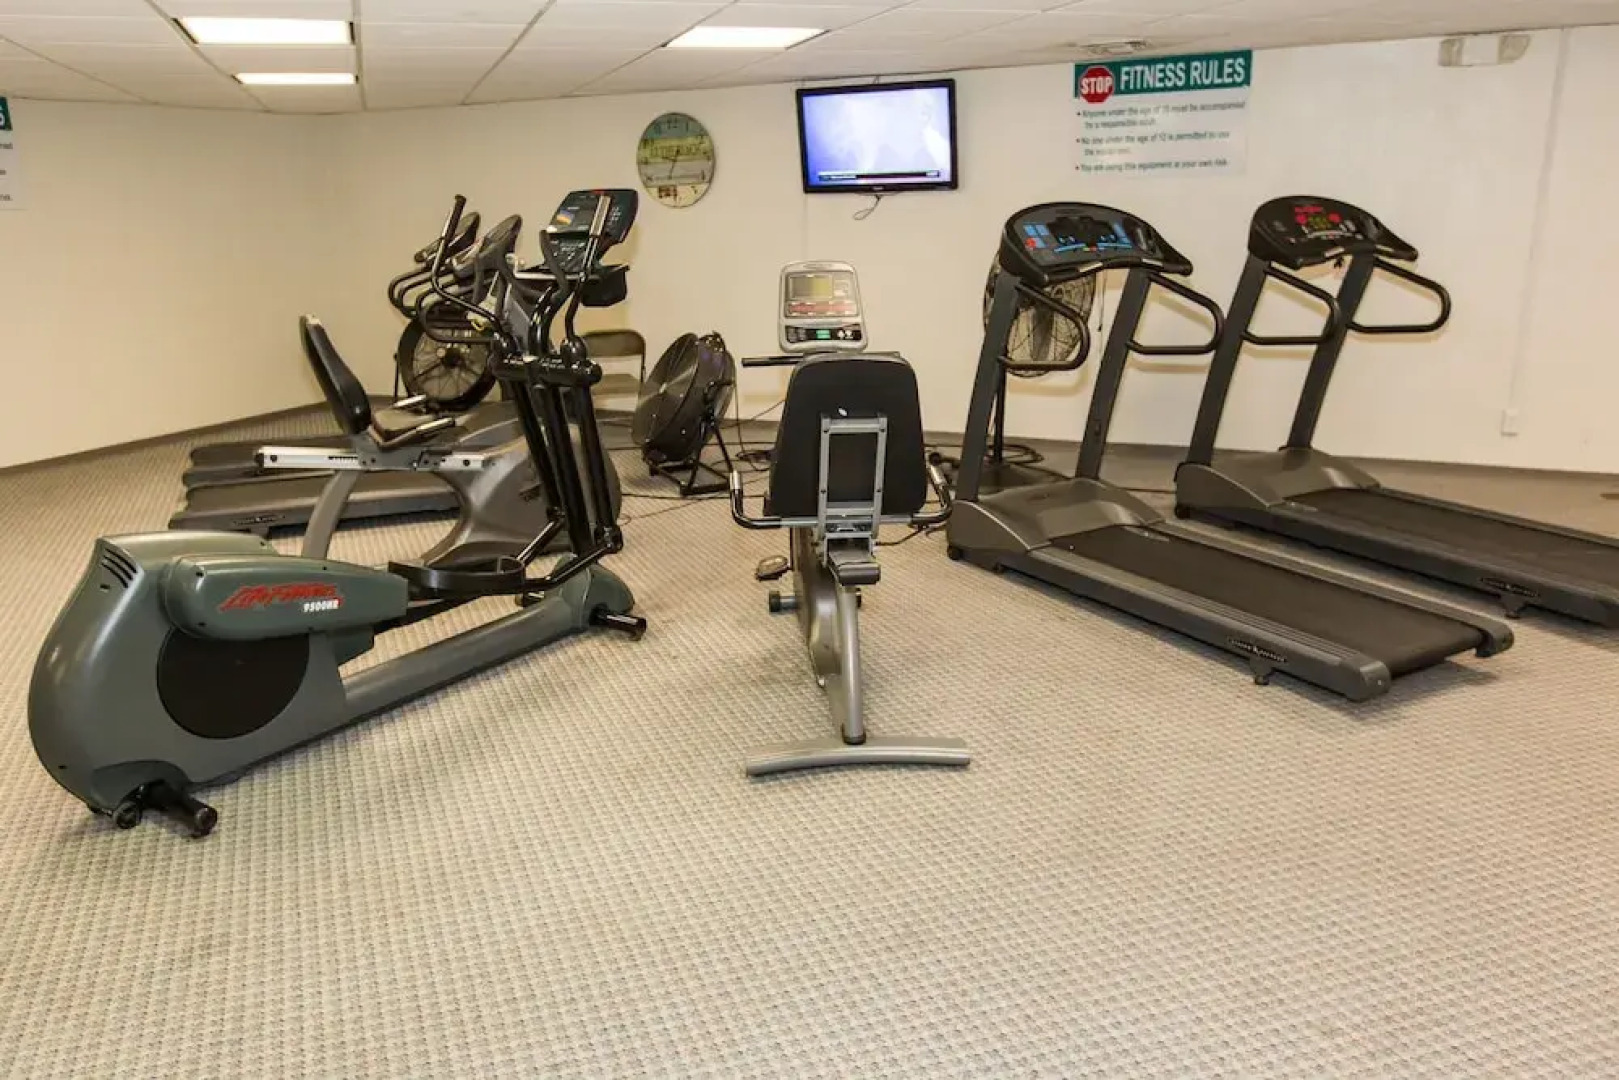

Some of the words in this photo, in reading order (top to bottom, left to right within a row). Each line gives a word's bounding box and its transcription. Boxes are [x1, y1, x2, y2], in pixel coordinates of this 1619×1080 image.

[1081, 76, 1113, 95] STOP
[1119, 62, 1186, 91] FITNESS
[1189, 57, 1246, 87] RULES
